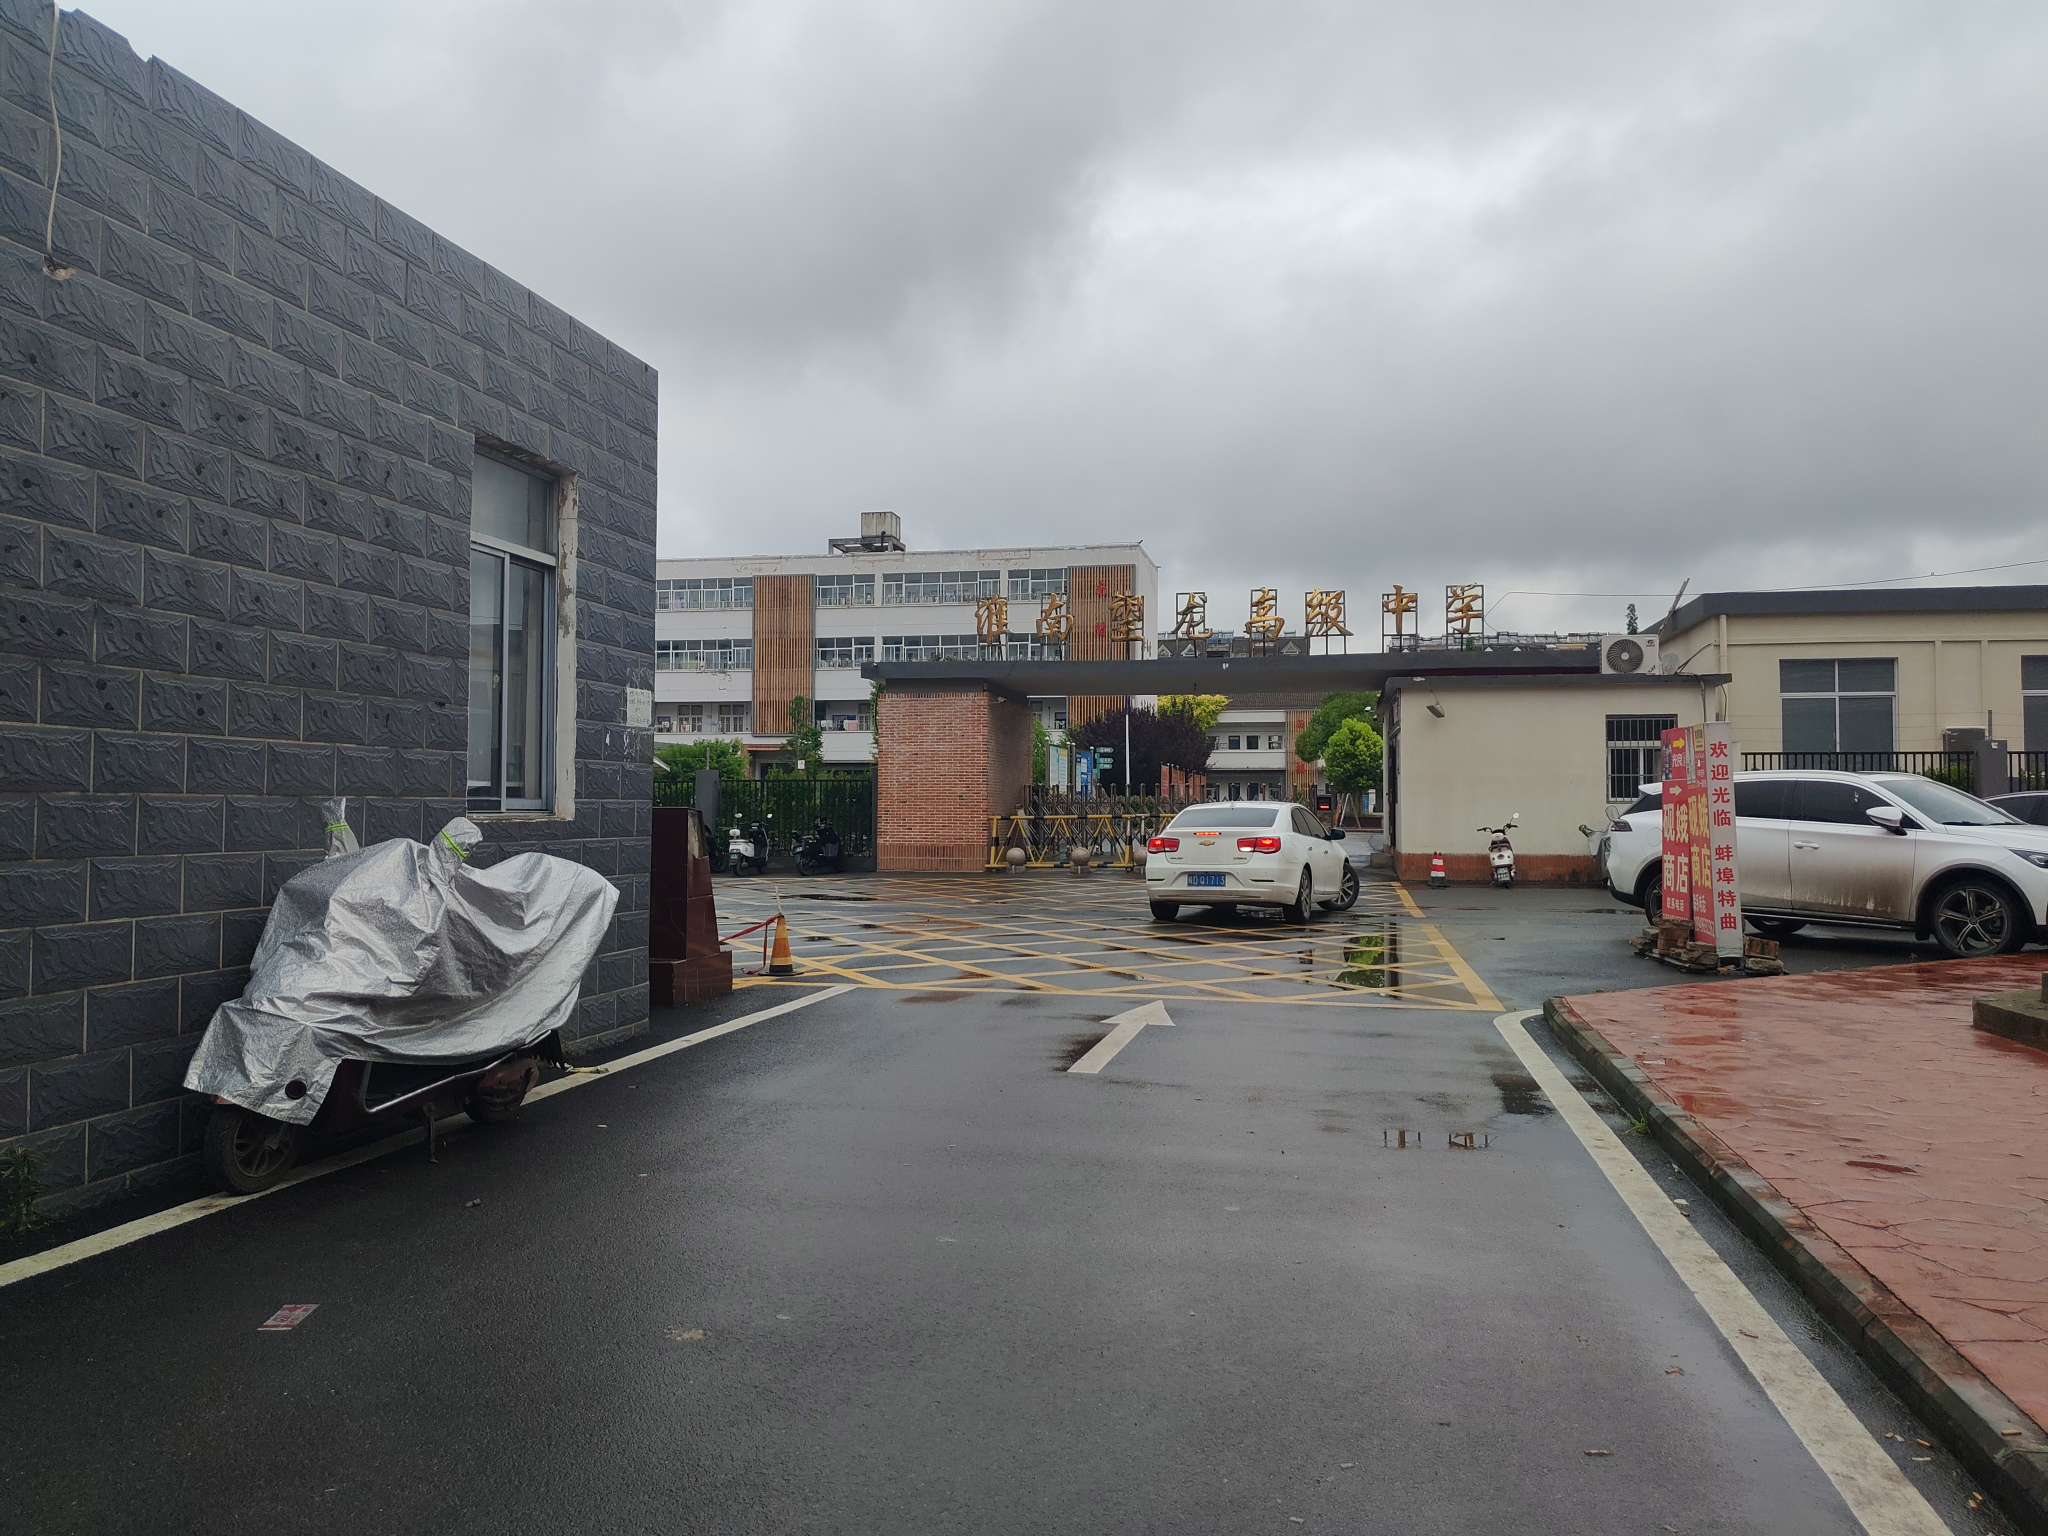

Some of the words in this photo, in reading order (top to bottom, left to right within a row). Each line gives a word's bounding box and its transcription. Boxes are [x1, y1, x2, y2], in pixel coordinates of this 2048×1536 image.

[1710, 741, 1731, 827] 欢迎光临
[1663, 851, 1688, 893] 商店
[1690, 843, 1712, 889] 商店
[1715, 844, 1737, 930] 蚌埠特曲
